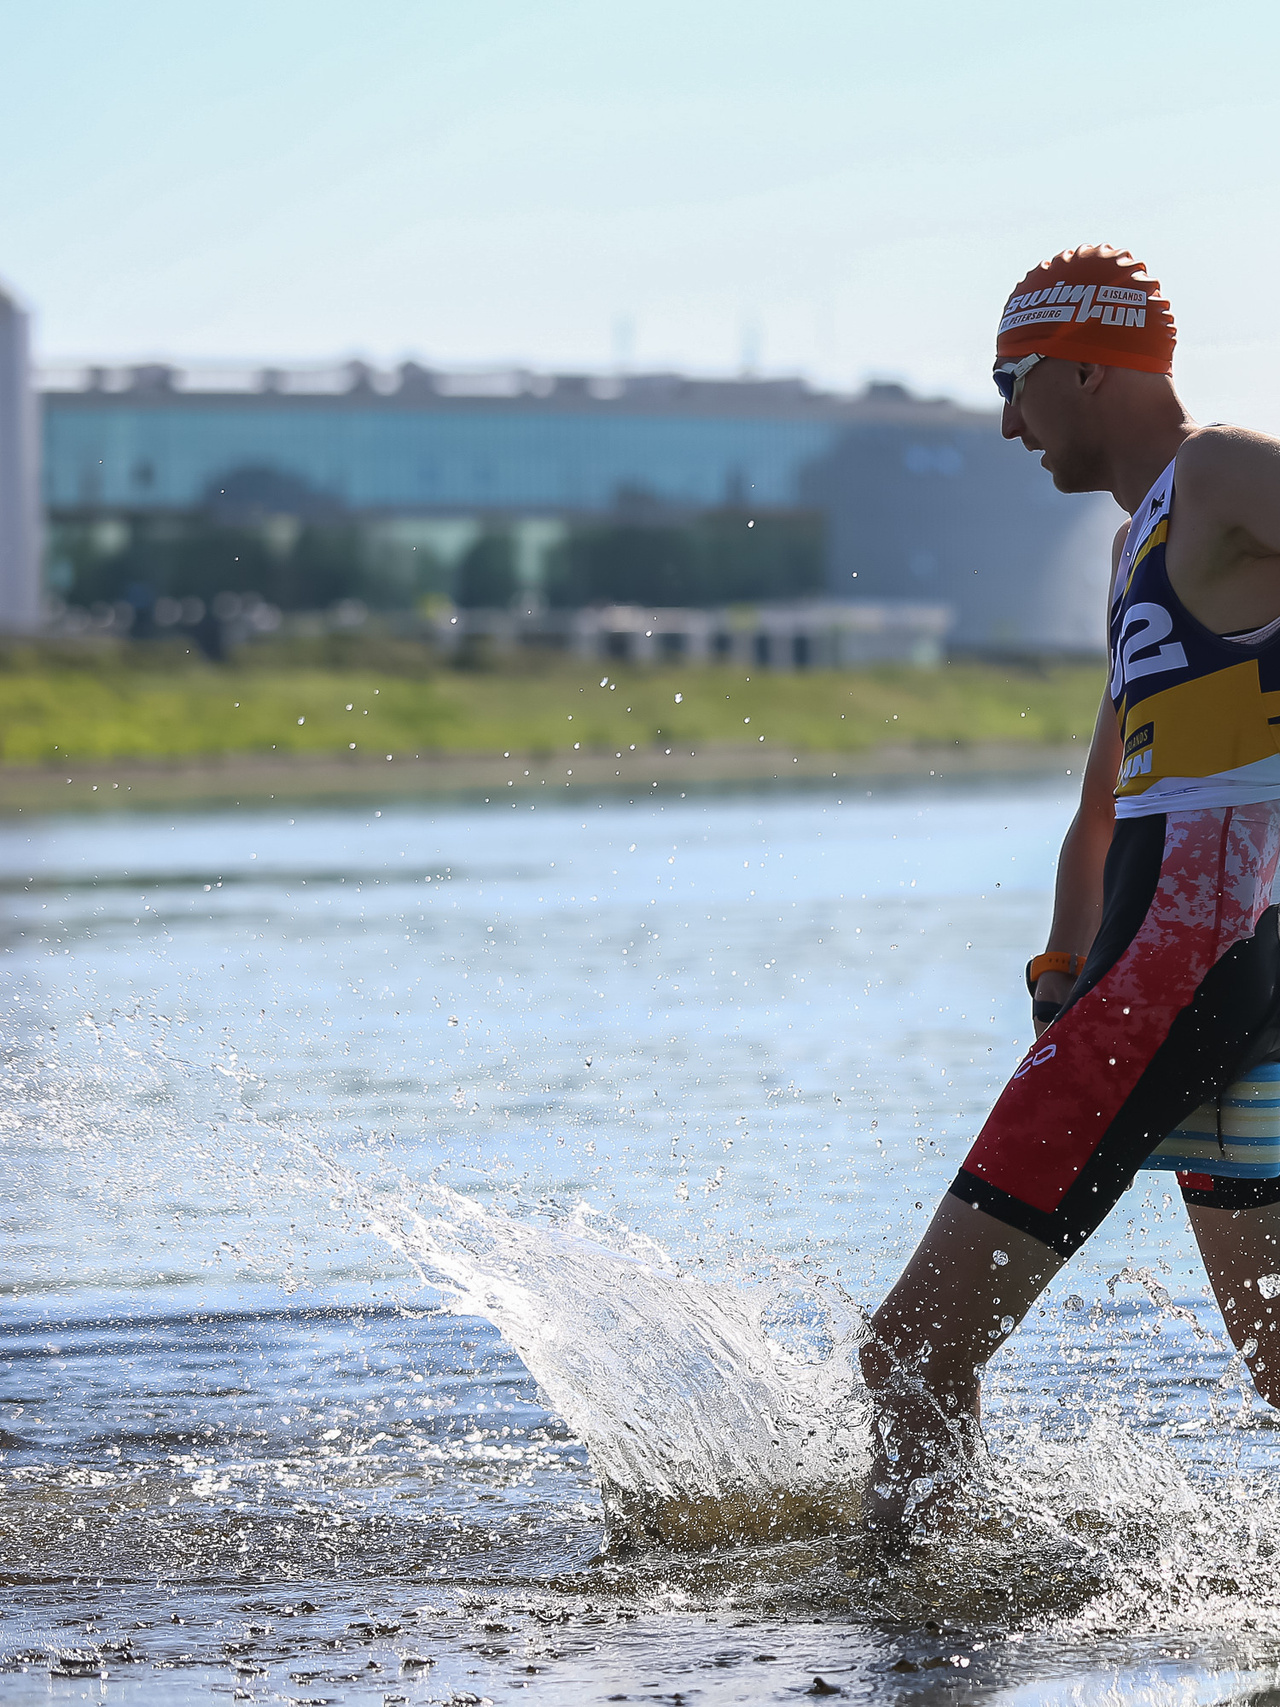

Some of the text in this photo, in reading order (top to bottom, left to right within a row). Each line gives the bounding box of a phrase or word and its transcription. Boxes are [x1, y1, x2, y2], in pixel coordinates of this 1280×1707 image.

[1102, 290, 1144, 302] 4 ISLANDS
[1009, 309, 1062, 326] PETERSBURG
